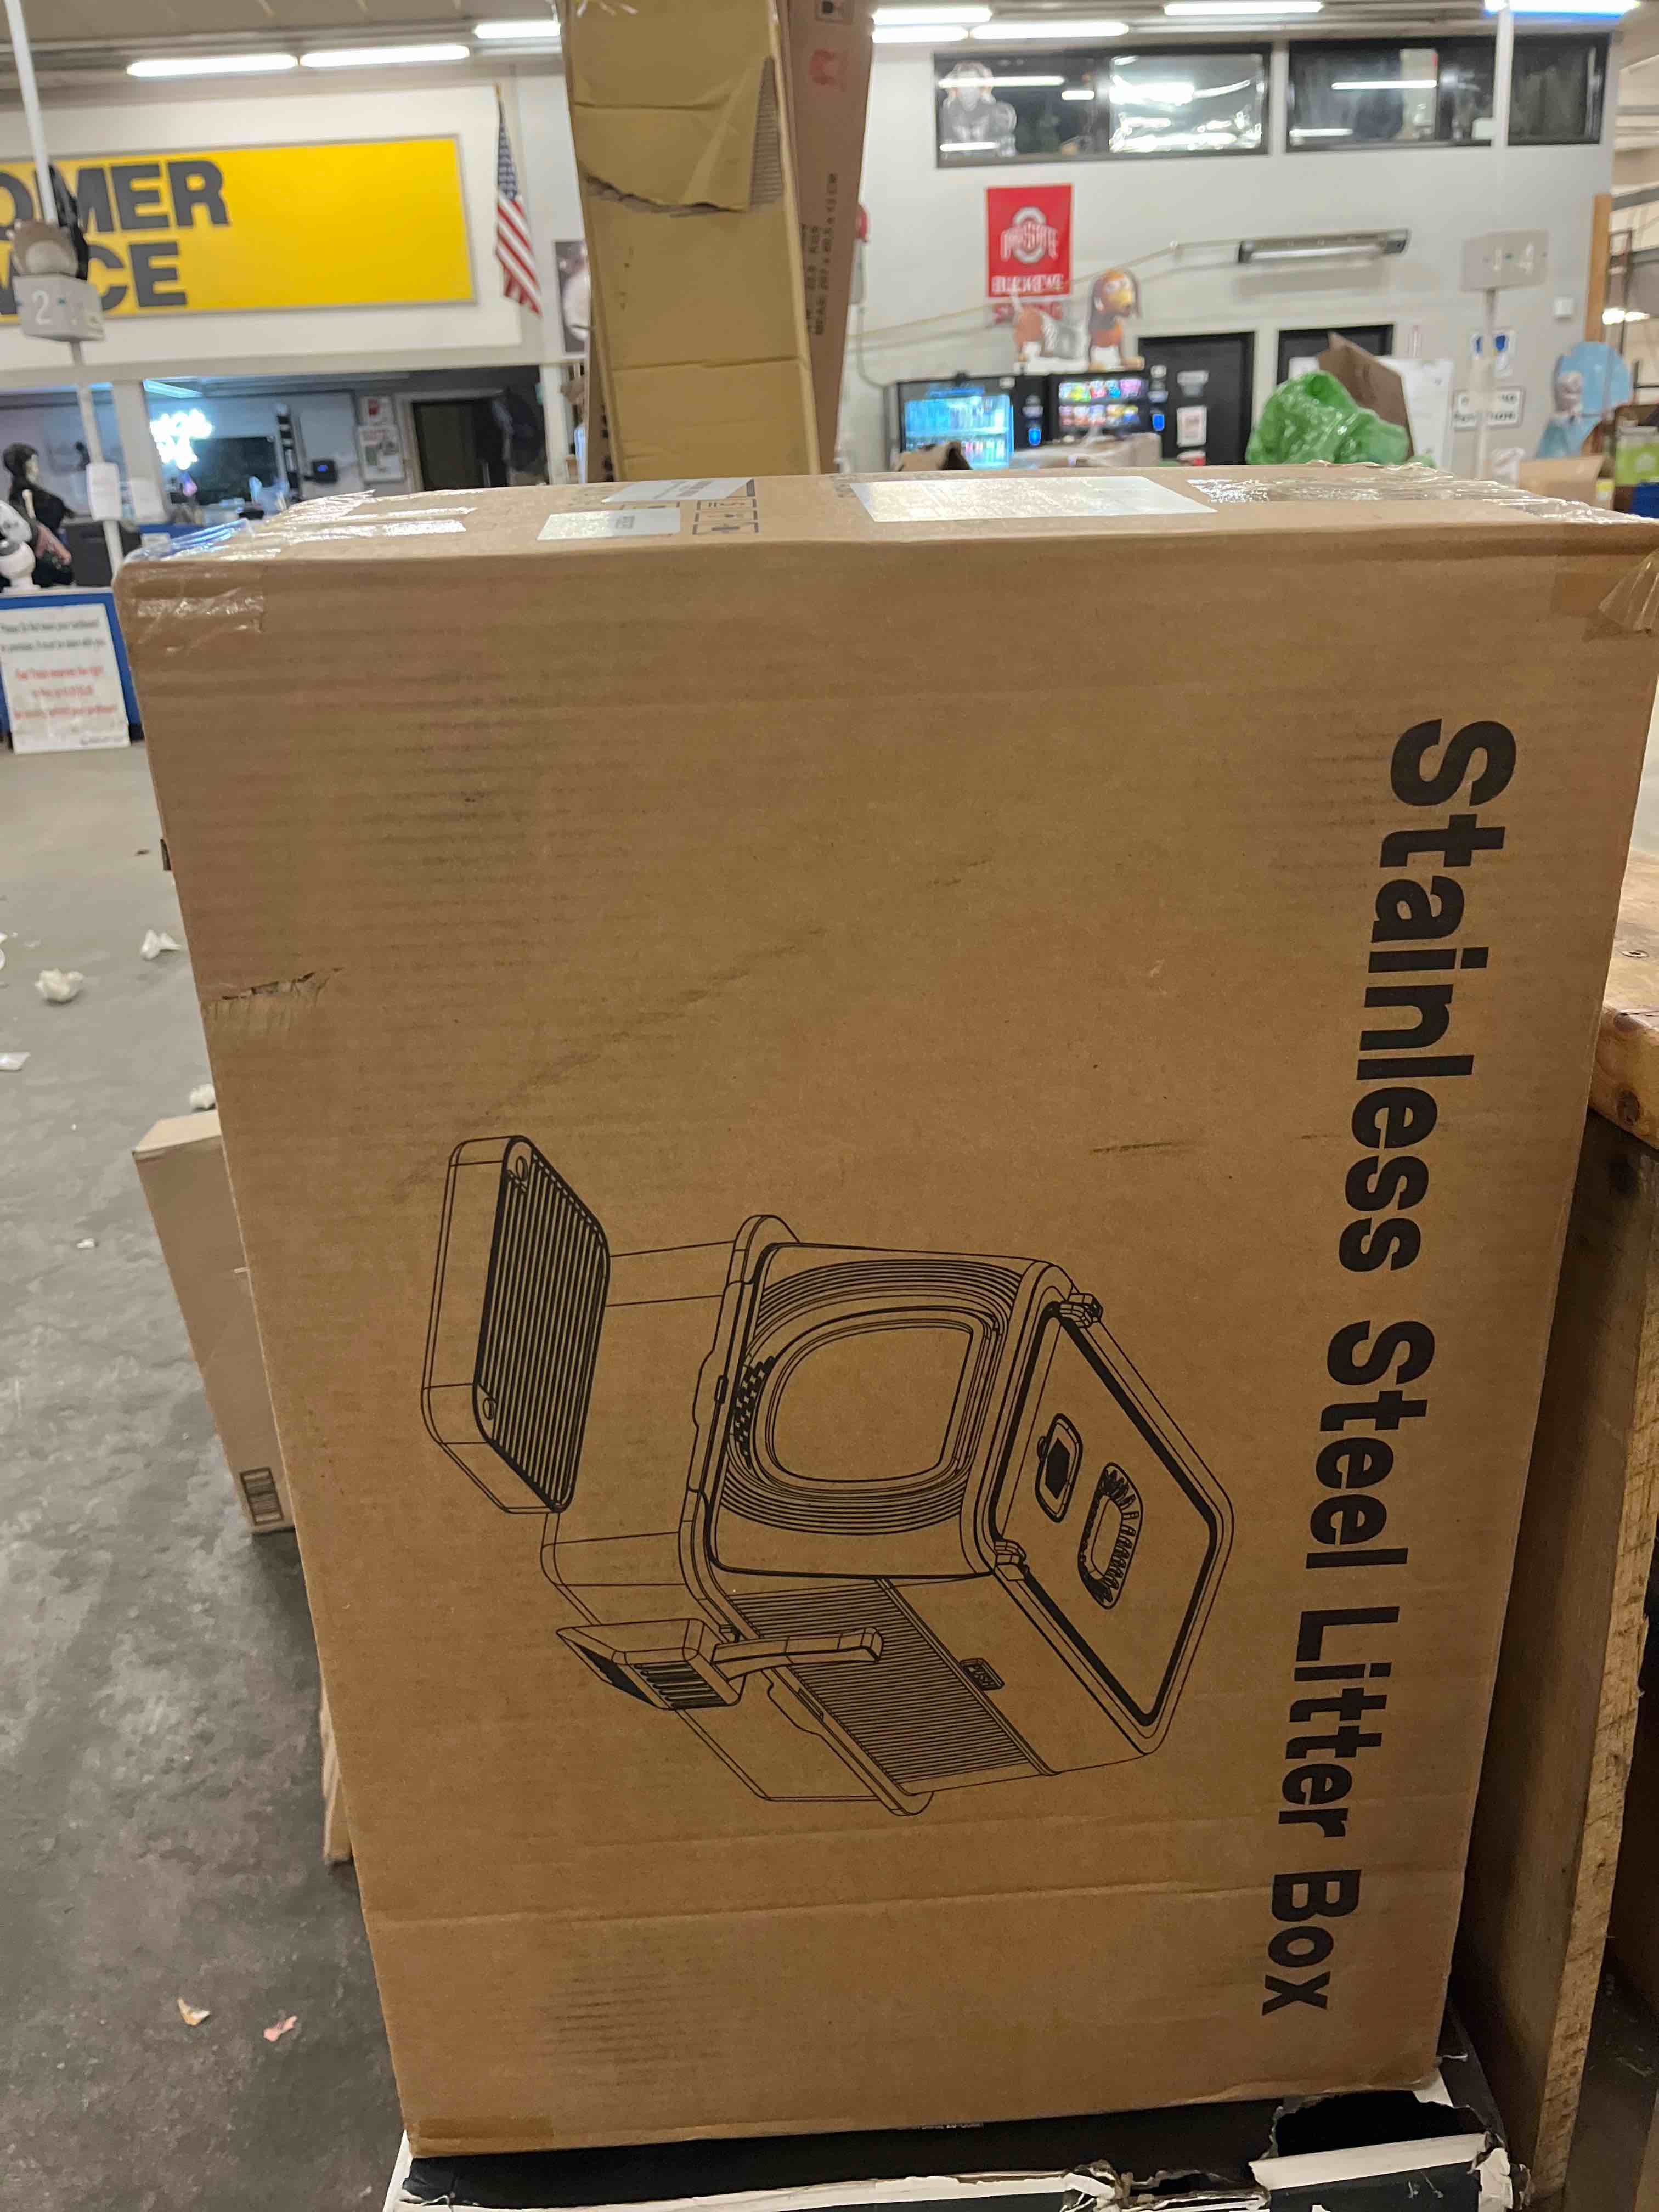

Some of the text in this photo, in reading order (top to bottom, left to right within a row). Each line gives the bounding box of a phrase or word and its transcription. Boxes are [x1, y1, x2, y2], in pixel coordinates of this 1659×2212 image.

[31, 289, 52, 325] 2
[1262, 719, 1516, 2016] Stainless Steel Litter Box
